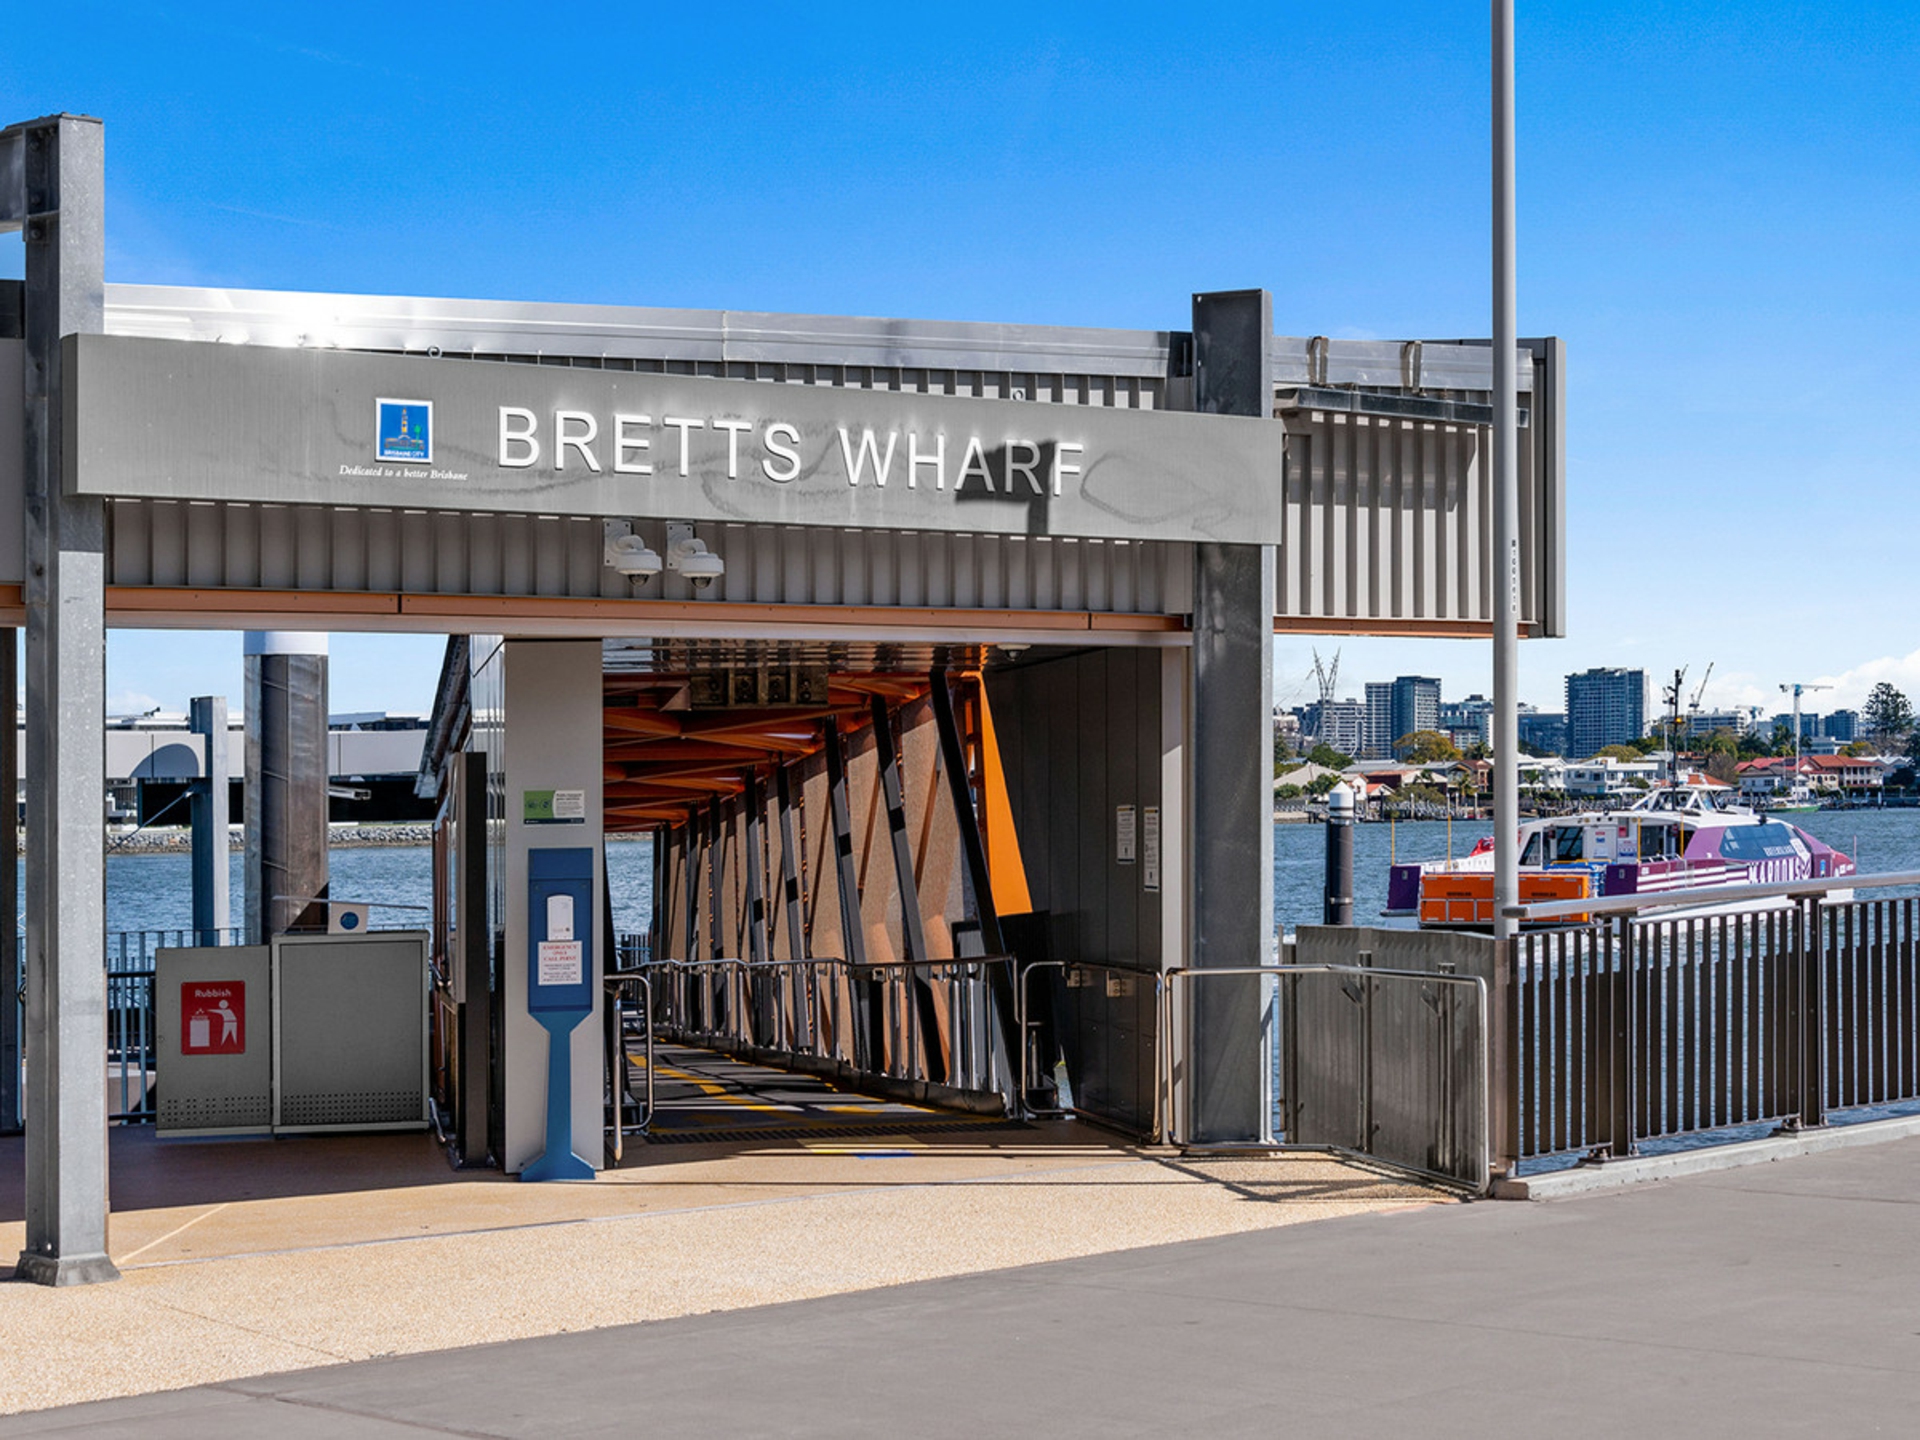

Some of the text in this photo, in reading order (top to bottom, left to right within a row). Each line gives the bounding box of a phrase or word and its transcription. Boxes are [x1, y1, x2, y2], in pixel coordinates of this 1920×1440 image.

[499, 406, 1084, 496] BRETTS WHARF
[339, 465, 383, 476] Dedicated
[384, 468, 393, 477] to
[403, 468, 428, 478] better
[430, 469, 468, 481] Brisbane
[195, 989, 232, 998] Rubbish
